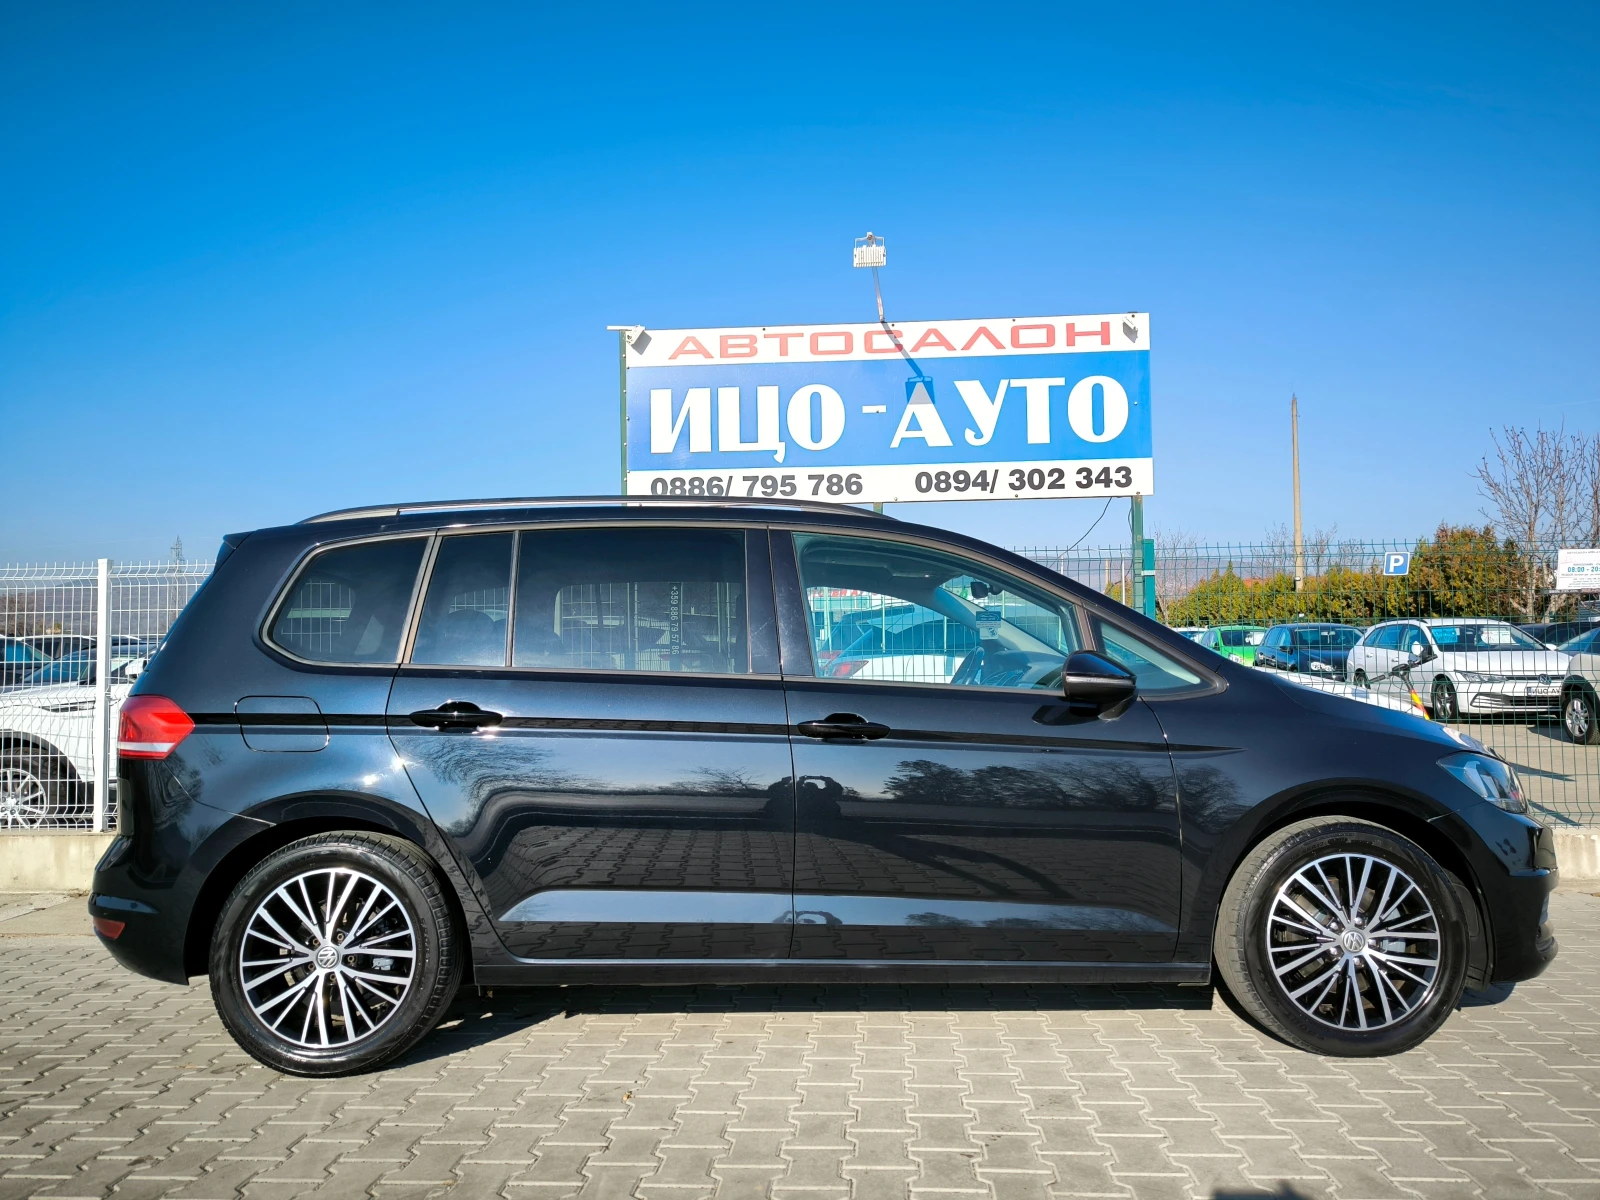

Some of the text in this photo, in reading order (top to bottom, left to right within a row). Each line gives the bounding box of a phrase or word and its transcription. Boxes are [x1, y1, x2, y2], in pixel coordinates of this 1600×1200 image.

[668, 321, 1111, 360] АВТОСАЛОН
[742, 475, 797, 497] 795
[807, 473, 863, 496] 786
[915, 466, 1132, 493] 0894/ 302 343
[1388, 555, 1405, 573] P
[670, 585, 680, 655] +359 886 79 57 86
